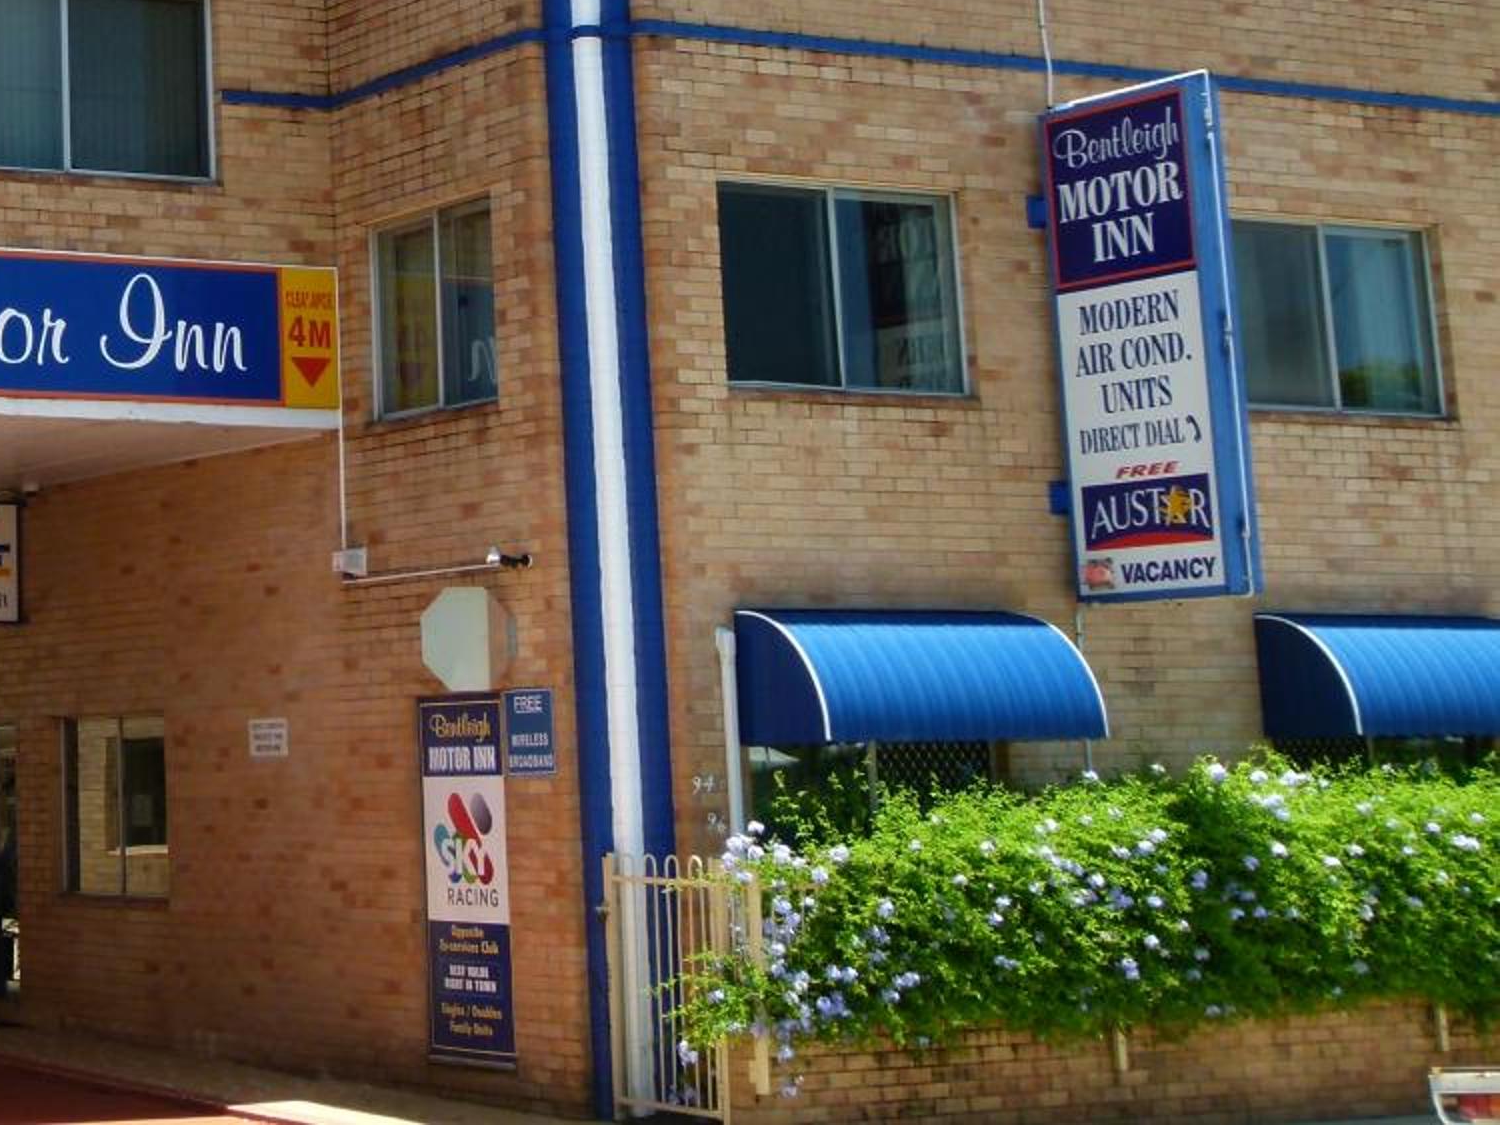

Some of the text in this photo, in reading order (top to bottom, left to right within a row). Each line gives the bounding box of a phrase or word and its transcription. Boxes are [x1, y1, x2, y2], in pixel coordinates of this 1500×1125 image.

[1052, 106, 1179, 168] Bentleigh
[1058, 161, 1184, 224] MOTOR
[1092, 212, 1156, 263] INN
[100, 273, 247, 372] Inn
[1079, 289, 1180, 336] MODERN
[1076, 332, 1193, 378] AIR COND.
[1100, 375, 1174, 415] UNITS
[1079, 417, 1186, 455] DIRECT DIAL
[1116, 461, 1180, 479] FREE
[1120, 556, 1217, 584] VACANCY
[429, 710, 491, 743] Bentleigh
[428, 746, 471, 772] MOTOR
[447, 888, 499, 907] RACING
